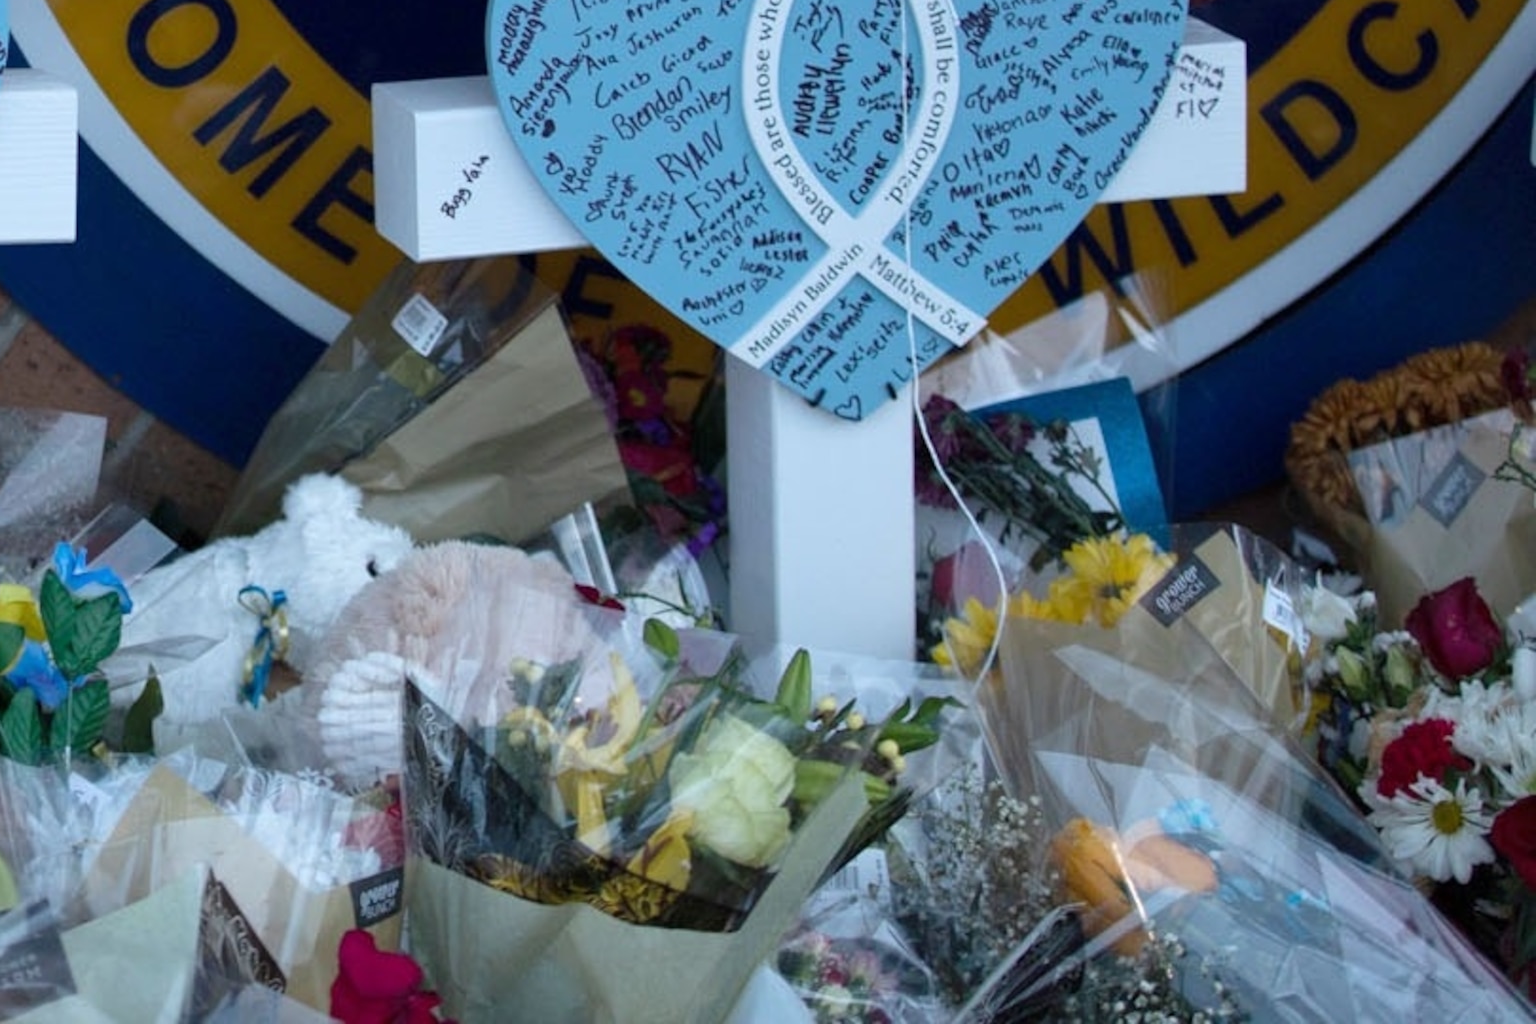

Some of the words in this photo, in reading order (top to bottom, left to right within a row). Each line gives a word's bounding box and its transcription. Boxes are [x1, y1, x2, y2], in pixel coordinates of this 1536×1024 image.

[926, 0, 955, 52] shall
[753, 47, 775, 113] those
[934, 56, 958, 85] be
[763, 114, 785, 153] are
[771, 152, 834, 226] Blessed
[746, 300, 808, 358] Madisyn
[803, 242, 864, 302] Baldwin
[868, 253, 941, 317] Matthew
[939, 307, 970, 337] 5:4
